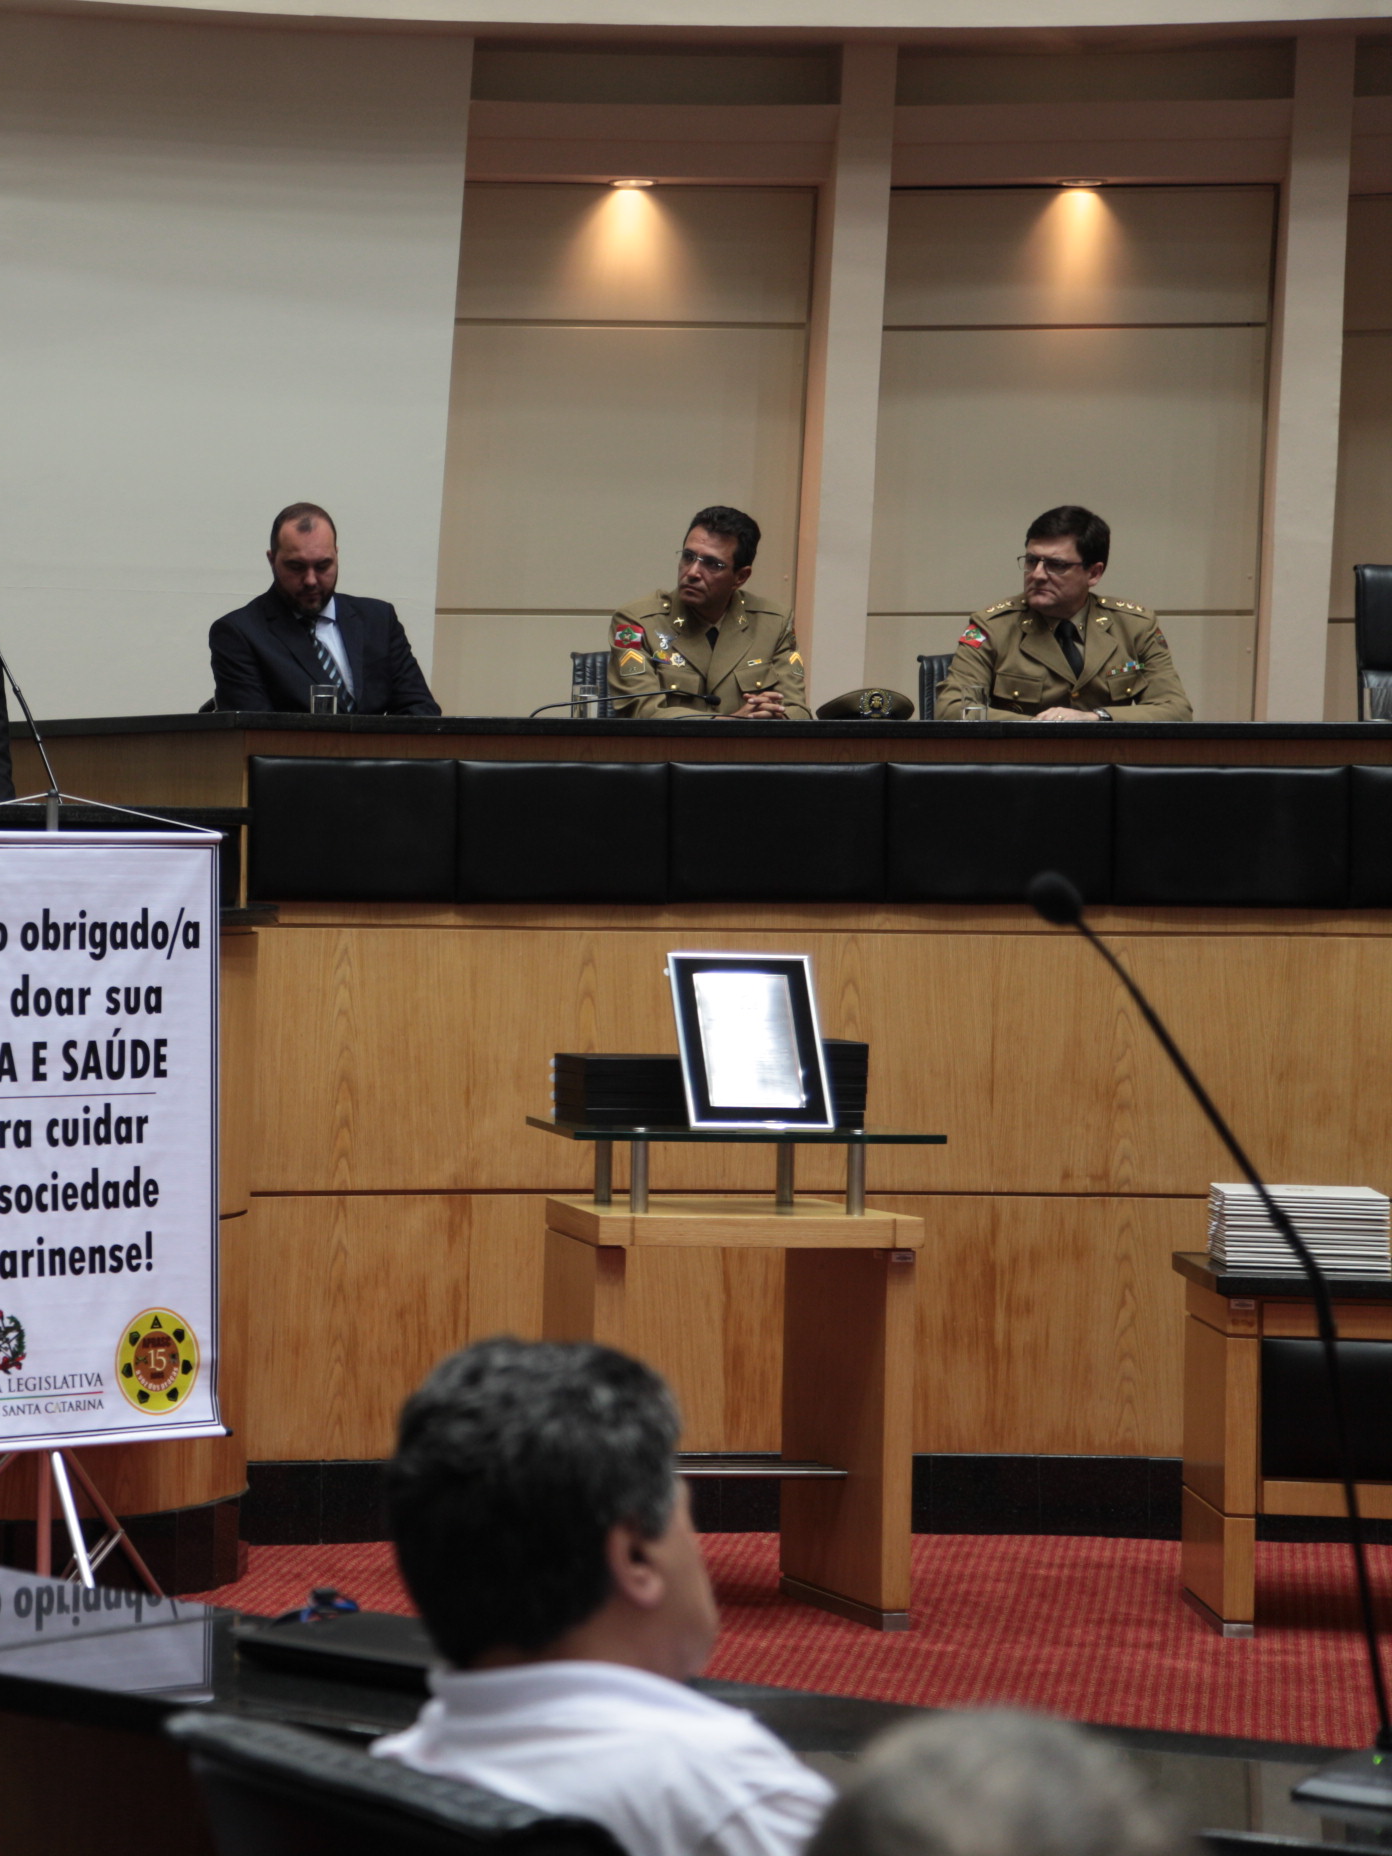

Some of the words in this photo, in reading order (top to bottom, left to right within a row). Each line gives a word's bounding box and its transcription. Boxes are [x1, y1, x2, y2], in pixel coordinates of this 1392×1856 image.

[20, 907, 201, 961] obrigado/a
[10, 974, 91, 1017] doar
[105, 986, 162, 1016] sua
[32, 1041, 48, 1082] E
[62, 1028, 168, 1081] SAÚDE
[46, 1102, 149, 1148] cuidar
[148, 1349, 167, 1371] 15
[8, 1372, 104, 1394] LEGISLATIVA
[2, 1402, 42, 1416] SANTA
[44, 1399, 105, 1414] CATARINA
